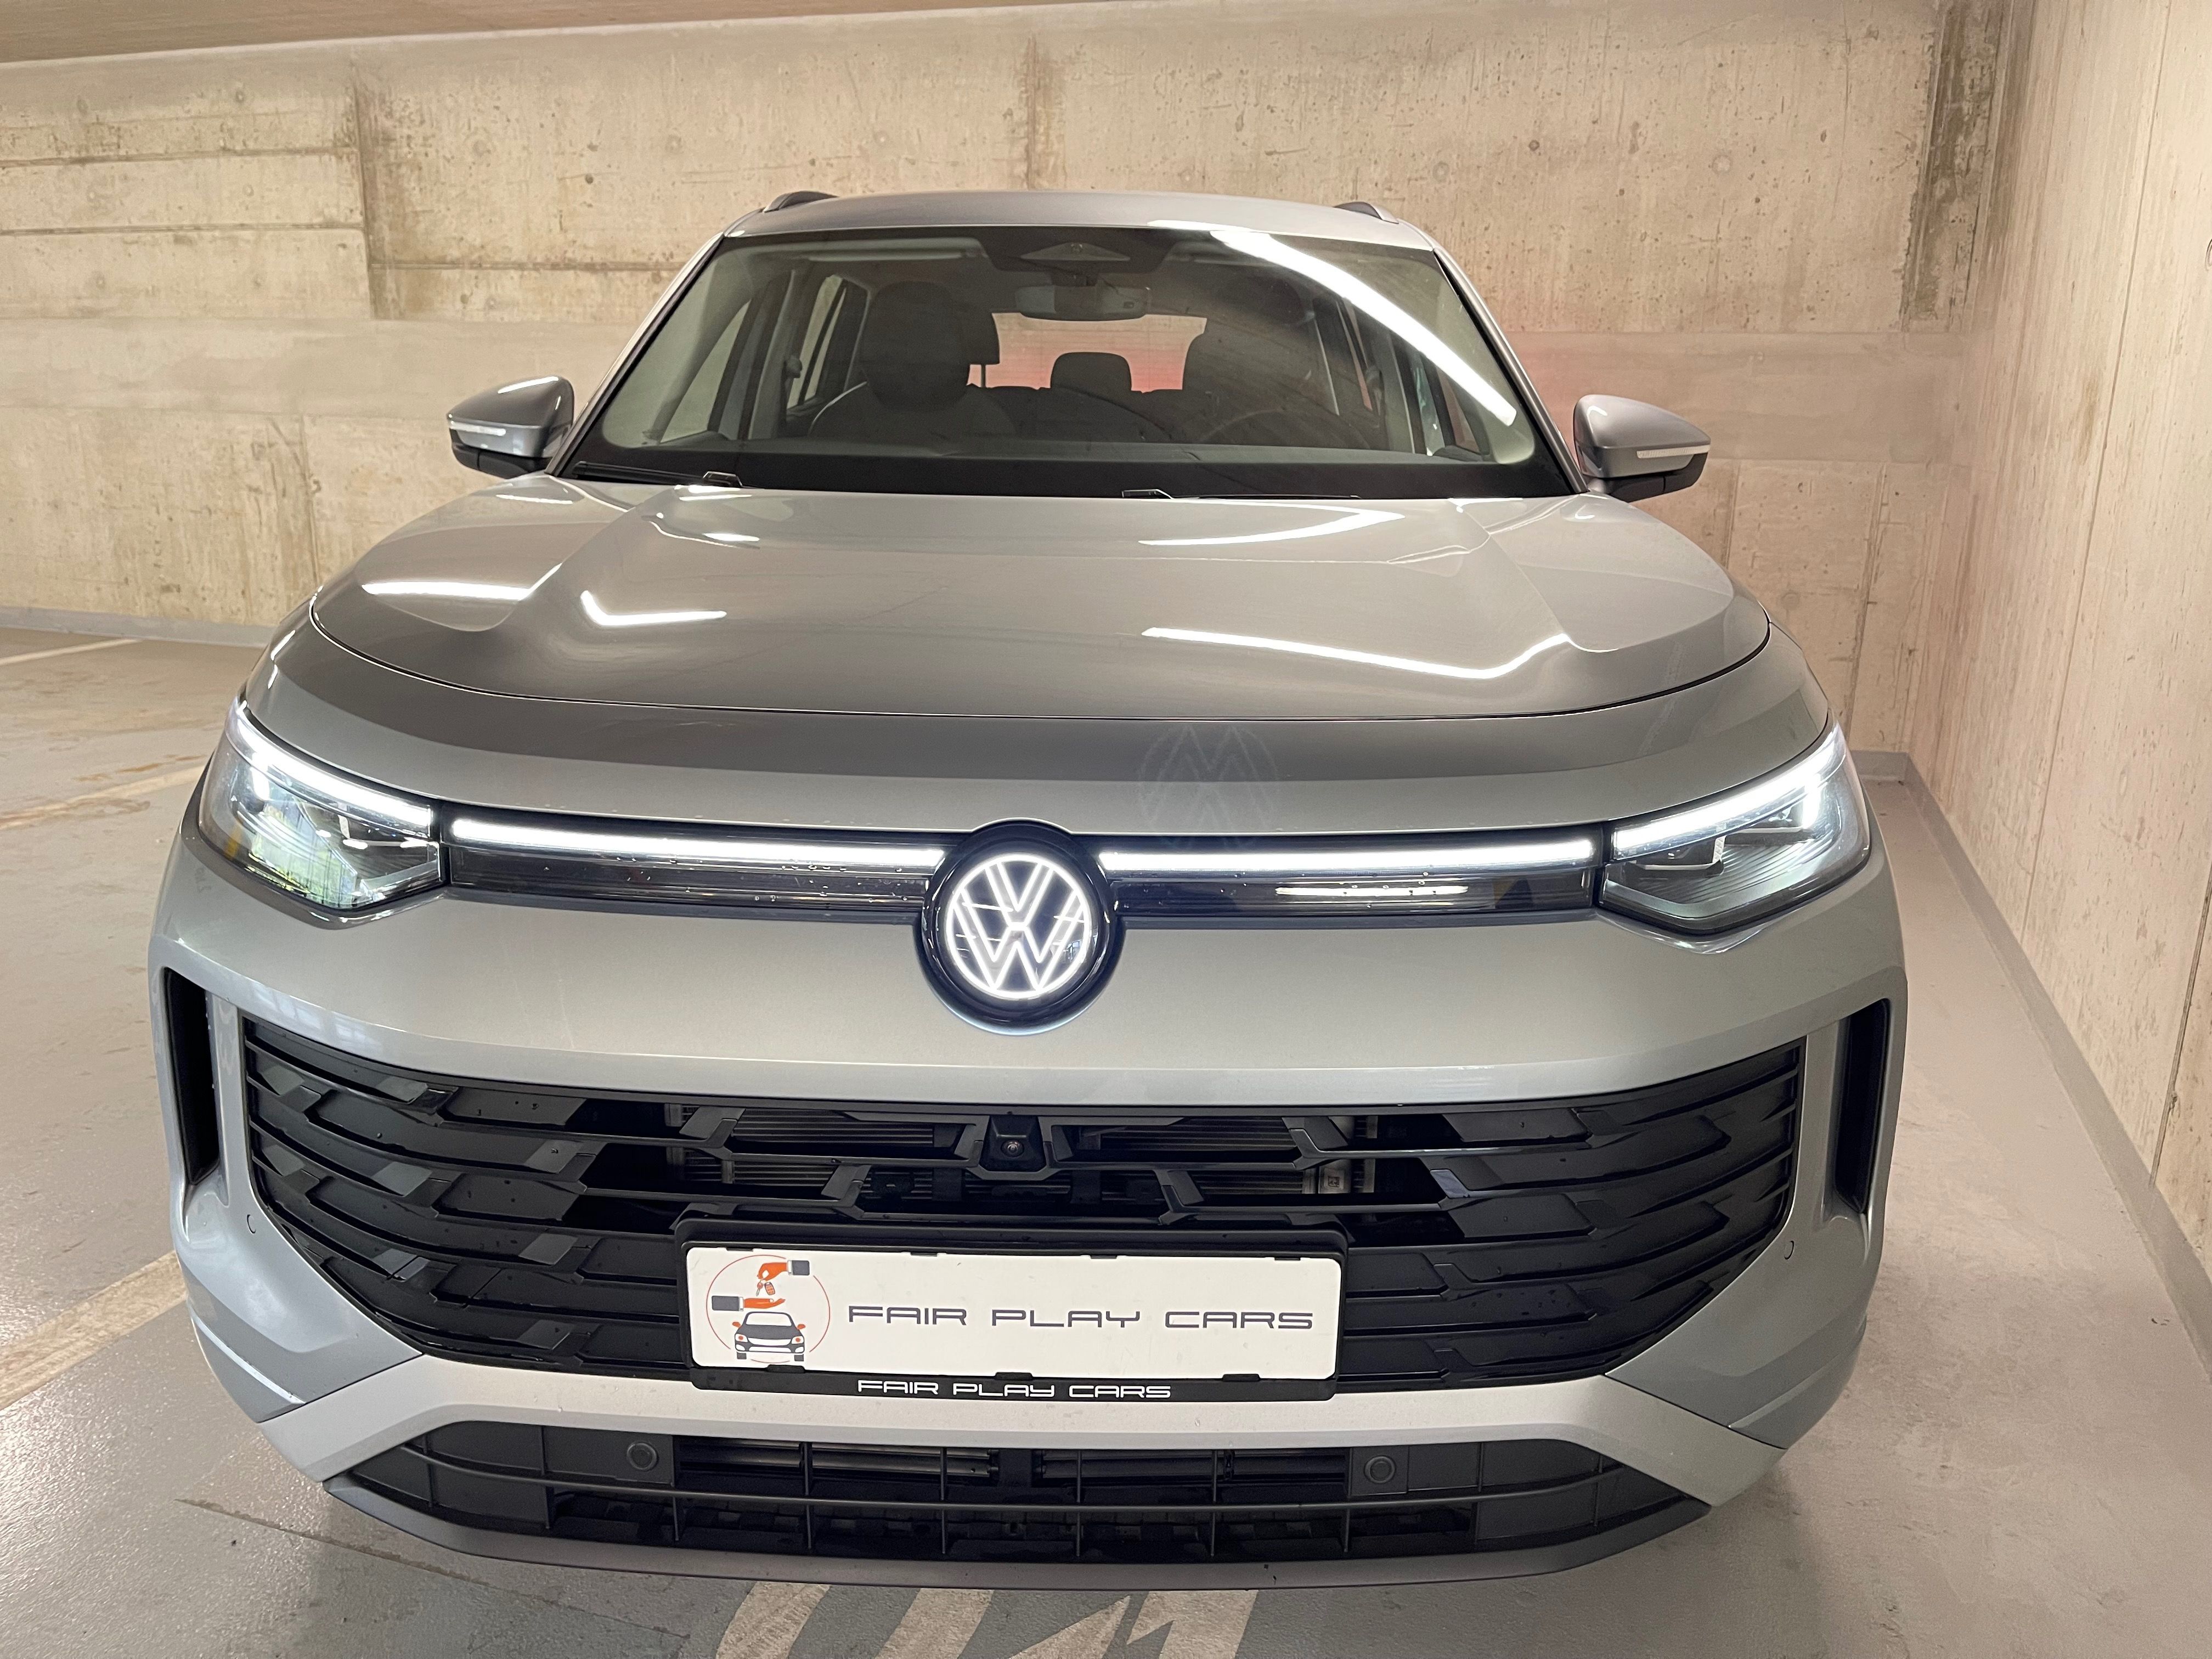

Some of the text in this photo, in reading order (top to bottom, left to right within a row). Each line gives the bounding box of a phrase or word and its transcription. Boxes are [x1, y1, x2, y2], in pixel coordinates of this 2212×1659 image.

[948, 856, 1090, 997] VW
[848, 1305, 1313, 1329] FAIR PLAY CARS
[857, 1380, 1171, 1398] FAIR PLAY CARS
